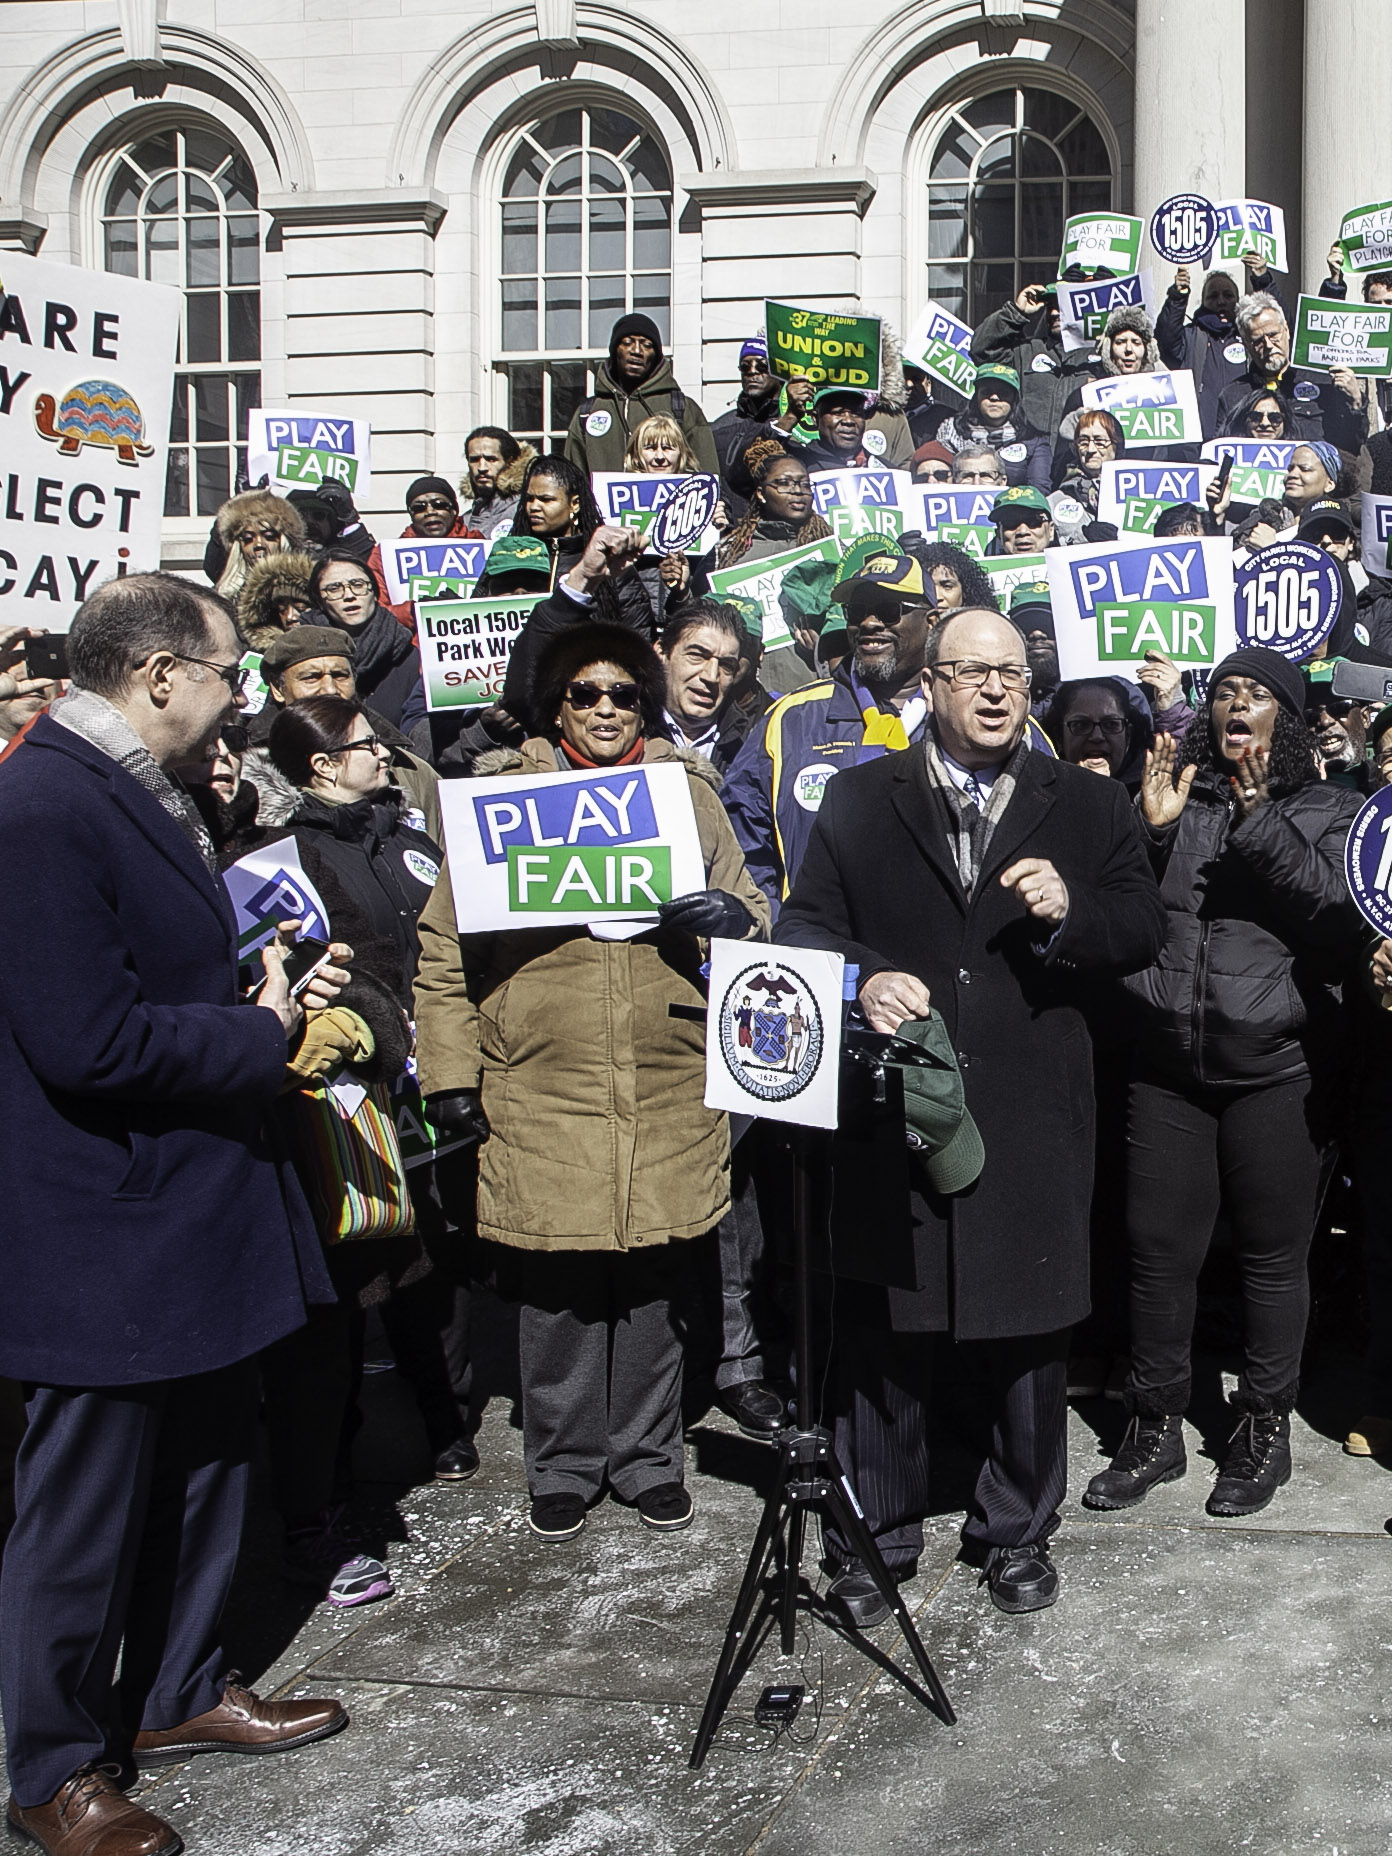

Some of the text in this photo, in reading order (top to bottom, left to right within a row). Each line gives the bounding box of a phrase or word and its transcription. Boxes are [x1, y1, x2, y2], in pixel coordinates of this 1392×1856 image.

[1096, 223, 1127, 236] FAIR
[1161, 209, 1208, 250] 1505
[1218, 205, 1268, 230] PLAY
[1345, 214, 1376, 235] PLAY
[1080, 236, 1106, 251] FOR
[1223, 232, 1274, 263] FAIR
[1074, 280, 1137, 316] PLAY
[814, 327, 830, 337] WAY
[822, 322, 836, 331] THE
[827, 315, 857, 326] LEADING
[932, 317, 974, 351] PLA
[1310, 313, 1387, 330] PLAY FAIR
[777, 330, 865, 358] UNION
[1331, 329, 1364, 349] FOR
[775, 358, 870, 385] PROUD
[811, 356, 823, 366] &
[926, 339, 977, 395] FAIR
[1099, 377, 1169, 409] PLAY
[270, 420, 350, 453] PLAY
[1113, 410, 1178, 438] FAIR
[280, 448, 352, 485] FAIR
[1219, 445, 1293, 469] PLAY
[1118, 471, 1196, 501] PLAY
[0, 472, 140, 533] LECT
[662, 486, 709, 542] 1505
[832, 507, 898, 544] FAIR
[400, 545, 478, 580] PLAY
[843, 534, 895, 563] THAT MAKES THIS
[1245, 544, 1322, 571] CITY PARKS WORKERS
[1262, 556, 1306, 571] LOCAL
[731, 572, 777, 598] PLAY
[1077, 548, 1197, 611] PLAY
[1242, 568, 1320, 642] 1505
[1322, 601, 1337, 632] SERVICE
[425, 608, 529, 638] Local 1505
[1102, 608, 1209, 656] FAIR
[436, 637, 484, 662] Park
[444, 661, 507, 687] SAVE
[483, 779, 640, 856] PLAY
[1356, 804, 1379, 838] DEBRIS
[516, 853, 663, 905] FAIR
[1351, 838, 1365, 892] REMOVERS
[1363, 898, 1384, 923] N.Y.C.
[1374, 893, 1385, 907] DC
[737, 1068, 781, 1097] CIVITATIS
[802, 1028, 819, 1074] EBORACI
